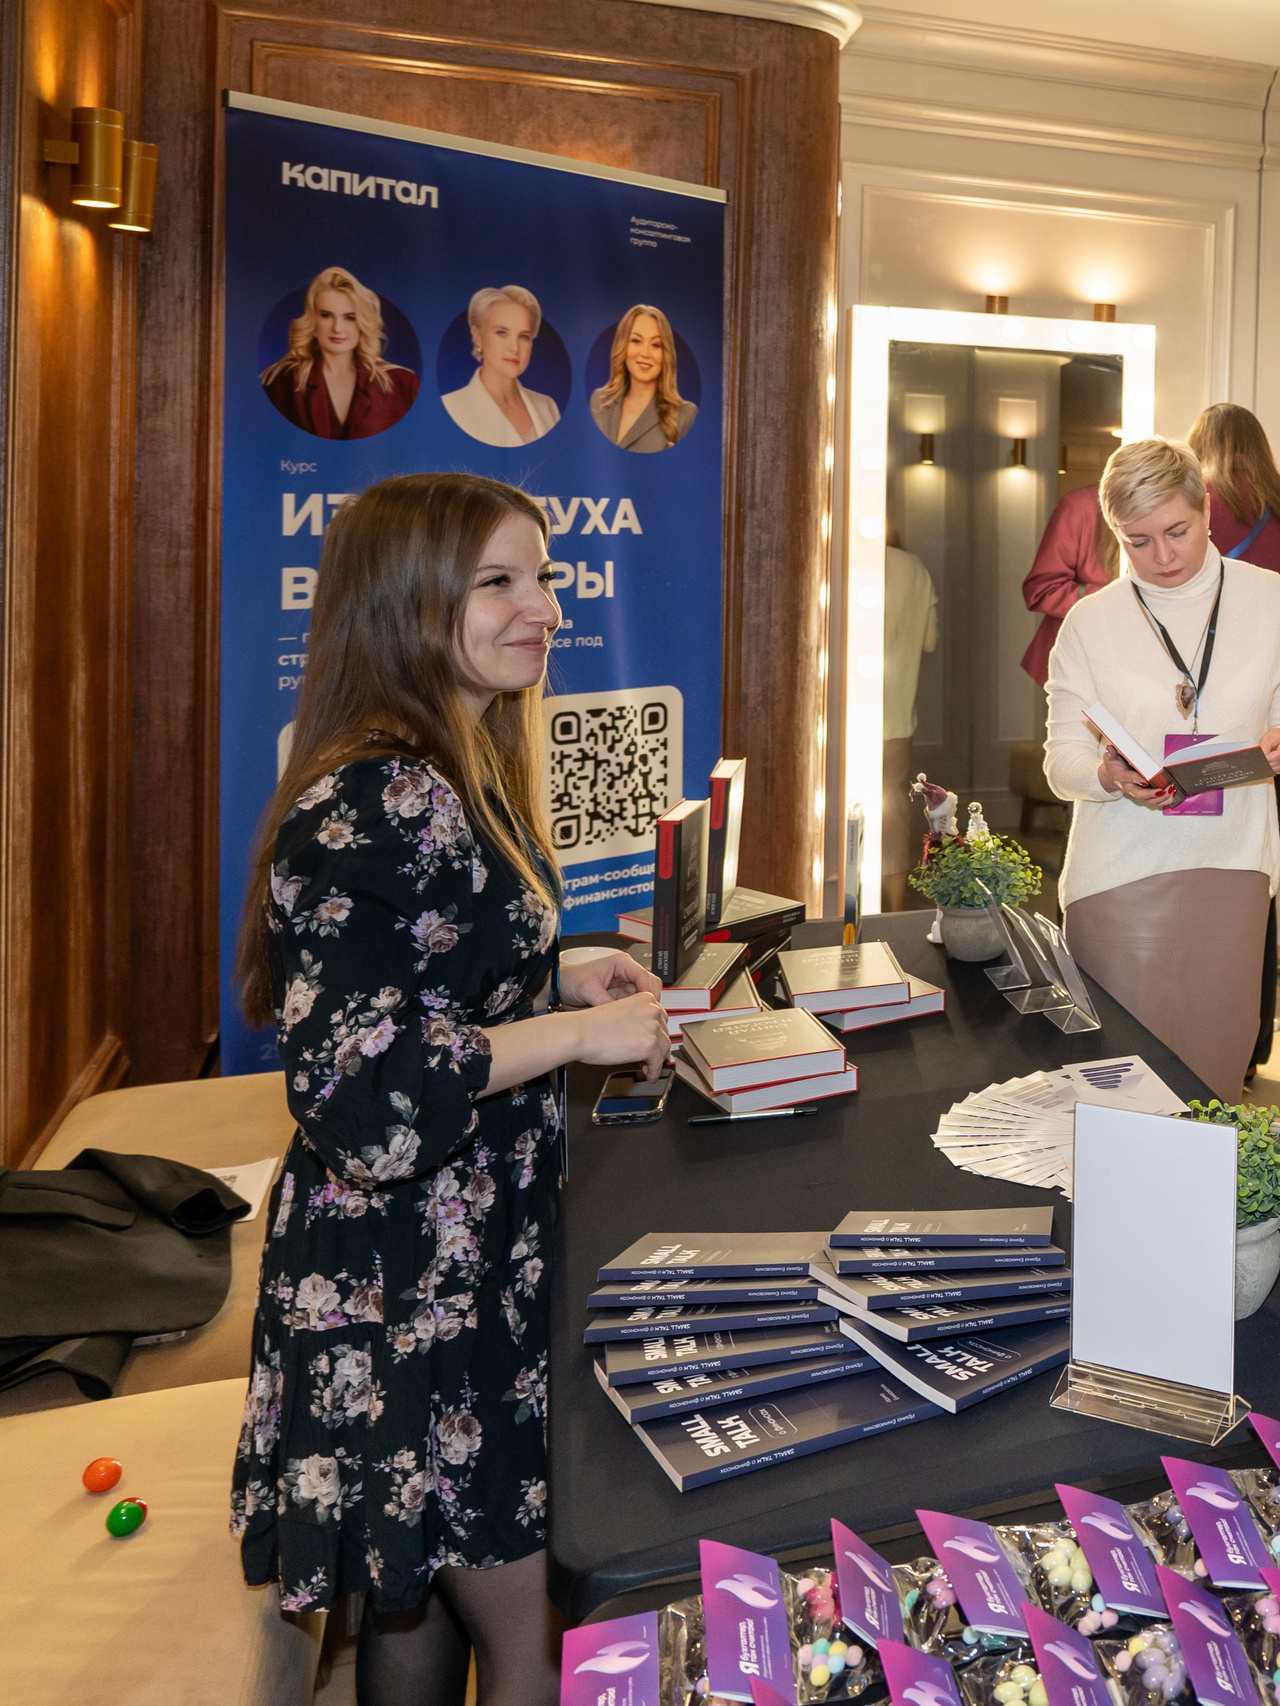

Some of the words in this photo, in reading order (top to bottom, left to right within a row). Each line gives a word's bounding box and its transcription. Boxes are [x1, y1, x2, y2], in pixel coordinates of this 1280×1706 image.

[280, 460, 318, 476] Курс
[531, 496, 643, 535] УХА
[576, 636, 604, 648] под
[278, 675, 306, 690] ру
[673, 1336, 698, 1356] TALK
[699, 1360, 721, 1368] SMALL
[907, 1343, 976, 1381] SMALL
[937, 1346, 994, 1372] TALK
[647, 1366, 677, 1375] финансах
[704, 1393, 721, 1401] TALK
[721, 1388, 742, 1397] SMALL
[668, 1397, 699, 1408] финансах
[758, 1408, 784, 1432] финансах
[680, 1414, 732, 1457] SMALL
[717, 1415, 760, 1449] TALK
[756, 1455, 772, 1463] TALK
[773, 1448, 794, 1458] SMALL
[719, 1460, 750, 1473] финансах
[1227, 1553, 1247, 1565] Я
[1122, 1580, 1141, 1593] Я
[988, 1602, 1008, 1614] Я
[746, 1618, 756, 1648] считаю!
[739, 1621, 749, 1660] бухгалтер,
[739, 1661, 760, 1676] Я
